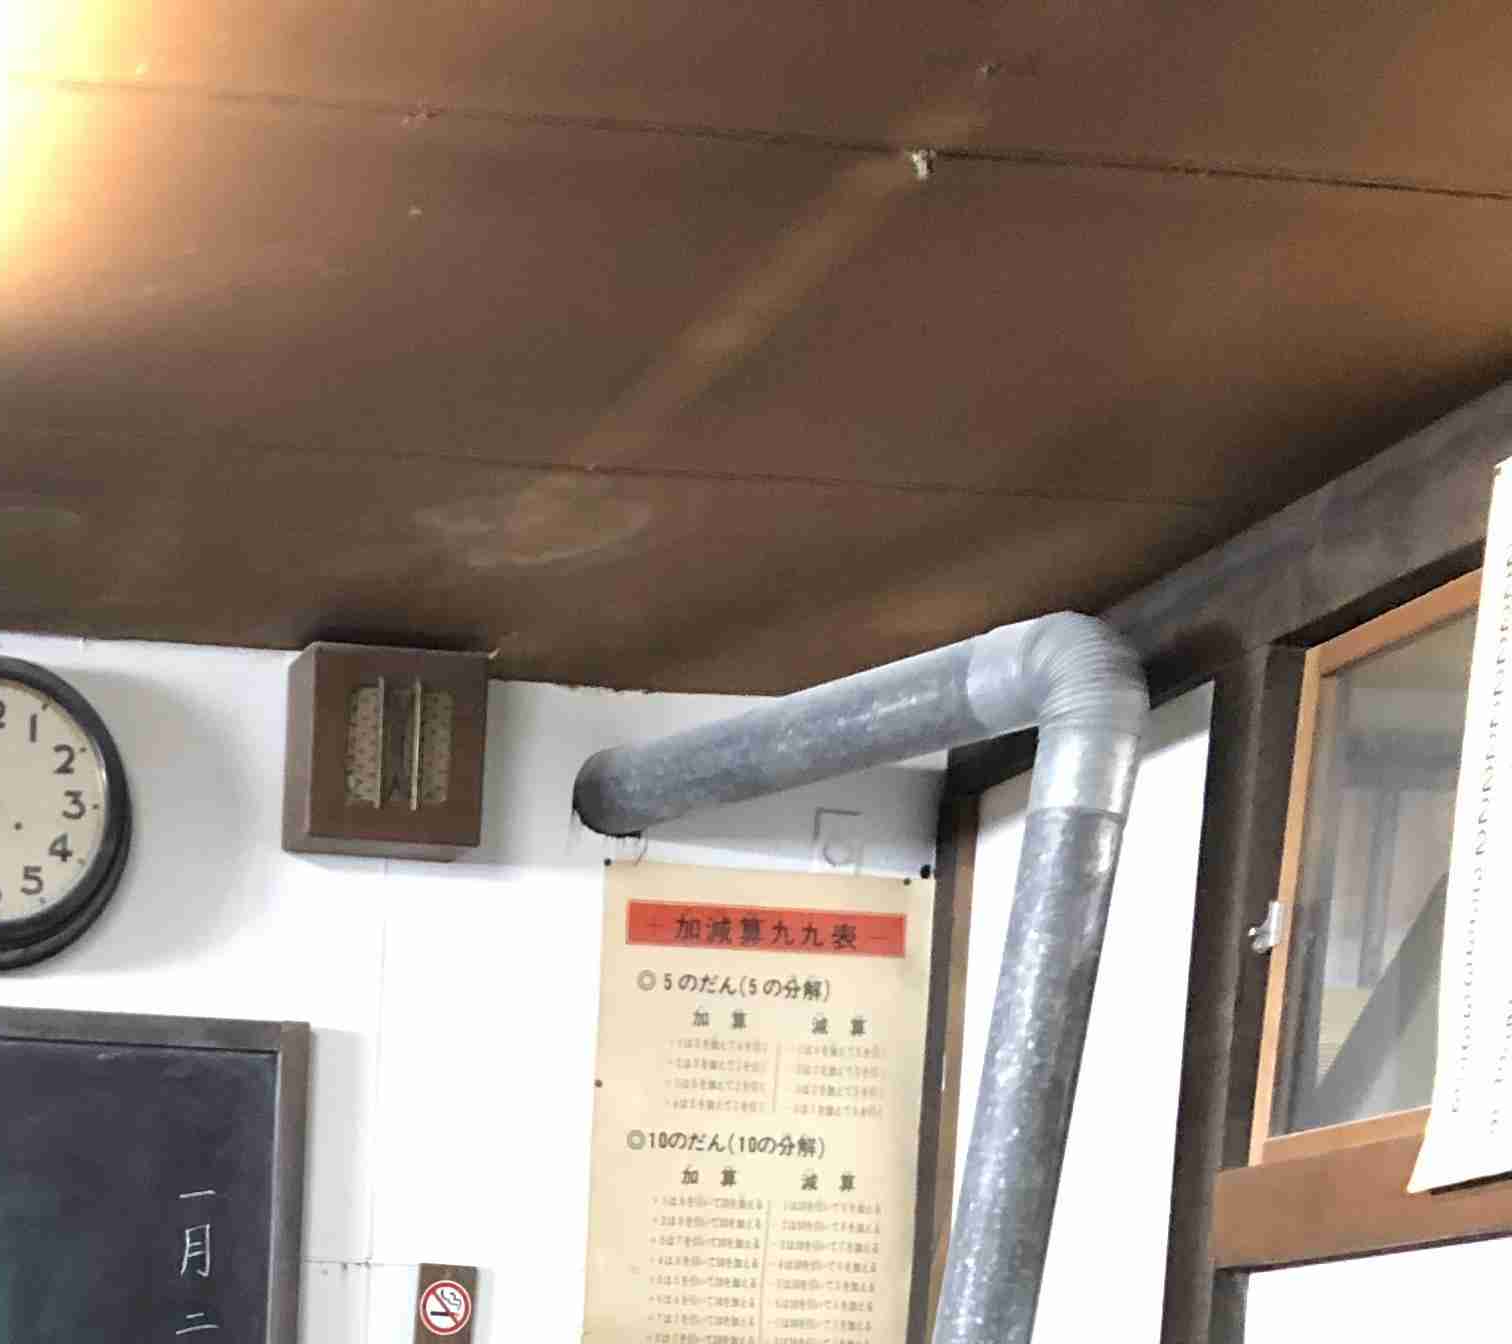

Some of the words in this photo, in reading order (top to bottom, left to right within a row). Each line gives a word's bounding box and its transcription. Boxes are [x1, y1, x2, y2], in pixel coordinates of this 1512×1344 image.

[28, 713, 38, 743] 1
[53, 744, 75, 774] 2
[62, 790, 86, 819] 3
[49, 834, 73, 862] 4
[20, 866, 44, 895] 5
